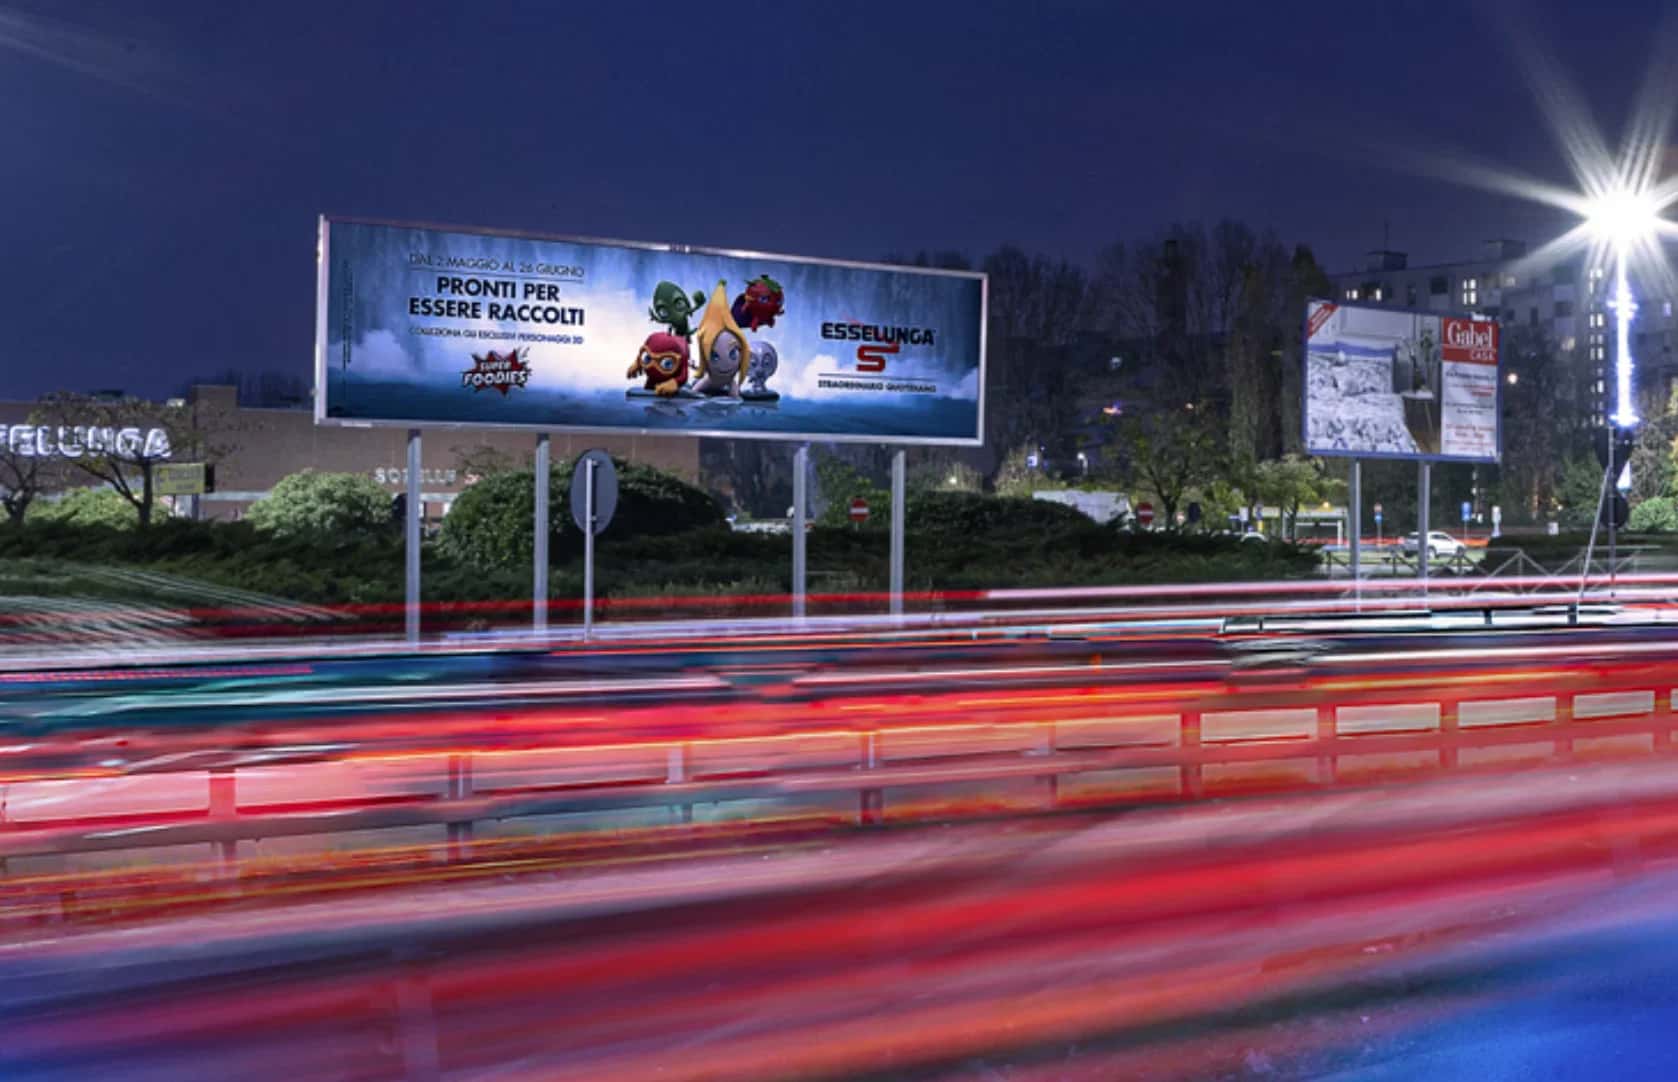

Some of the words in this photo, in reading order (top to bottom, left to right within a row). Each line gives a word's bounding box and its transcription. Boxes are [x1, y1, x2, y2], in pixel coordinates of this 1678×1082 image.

[447, 256, 500, 271] MAGGIO
[502, 260, 516, 272] AL
[536, 263, 585, 278] GIUGNO
[437, 276, 516, 299] PRONTI
[523, 282, 560, 303] PER
[409, 297, 482, 319] ESSERE
[488, 302, 585, 326] RACCOLTI
[821, 322, 935, 346] ESSELUNGA
[1448, 320, 1493, 349] Gabel
[463, 370, 528, 387] FOODIES
